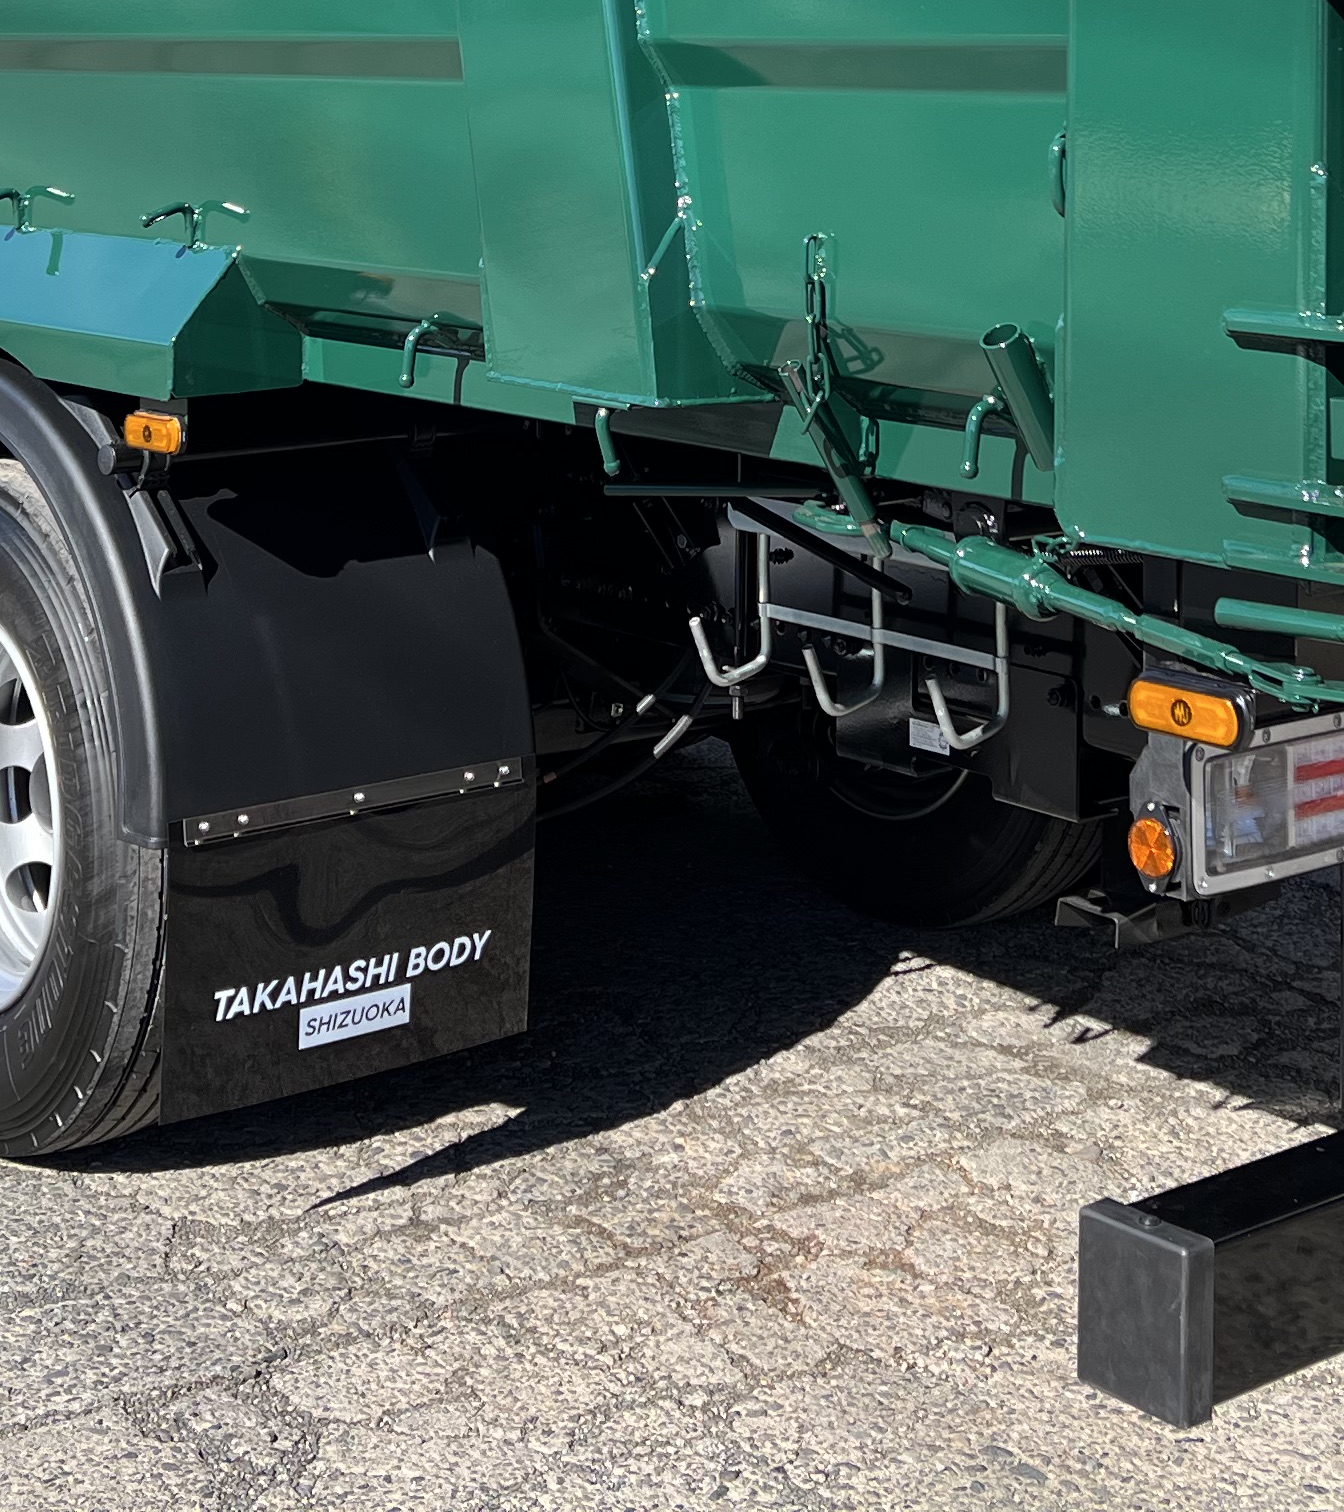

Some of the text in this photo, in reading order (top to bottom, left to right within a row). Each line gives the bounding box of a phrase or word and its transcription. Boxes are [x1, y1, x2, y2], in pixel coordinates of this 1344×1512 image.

[213, 929, 492, 1022] TAKAHASHI BODY
[304, 996, 406, 1037] SHIZUOKA
